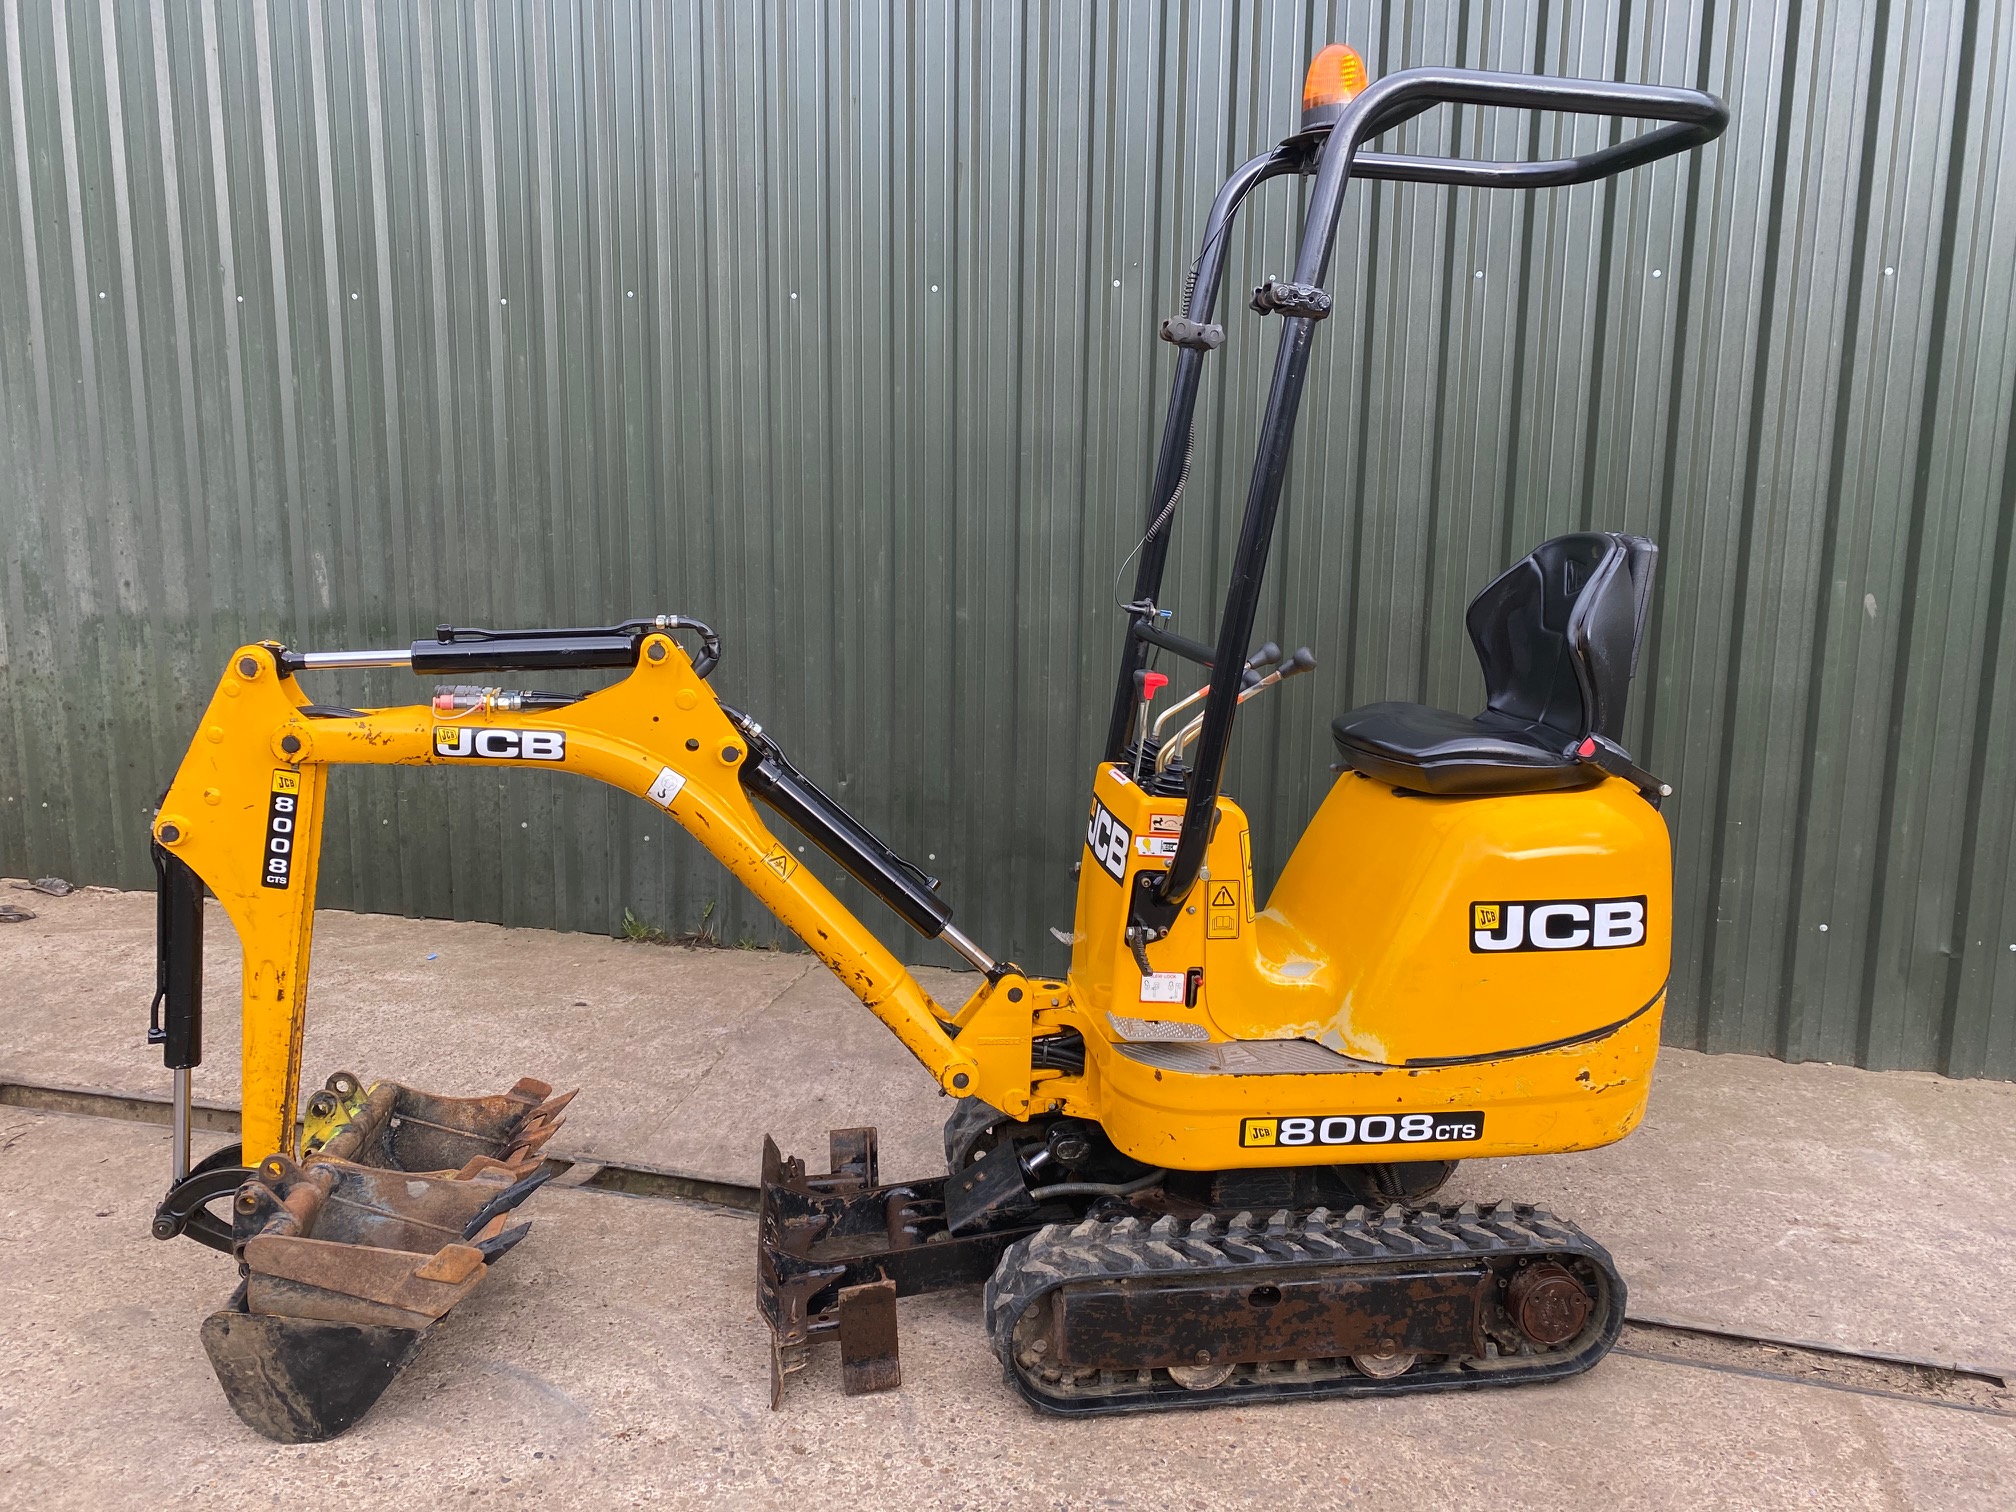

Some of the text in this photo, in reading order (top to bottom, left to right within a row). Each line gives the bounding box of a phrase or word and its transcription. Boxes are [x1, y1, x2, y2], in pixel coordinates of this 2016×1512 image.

[438, 729, 563, 759] JCB
[442, 730, 455, 740] JCB
[279, 777, 294, 788] JCB
[269, 797, 293, 873] 8008
[1088, 802, 1130, 879] JCB
[267, 875, 286, 884] CTS
[1475, 902, 1644, 950] JCB
[1481, 909, 1496, 925] JCB
[1253, 1114, 1476, 1145] JCB 8008 CTS
